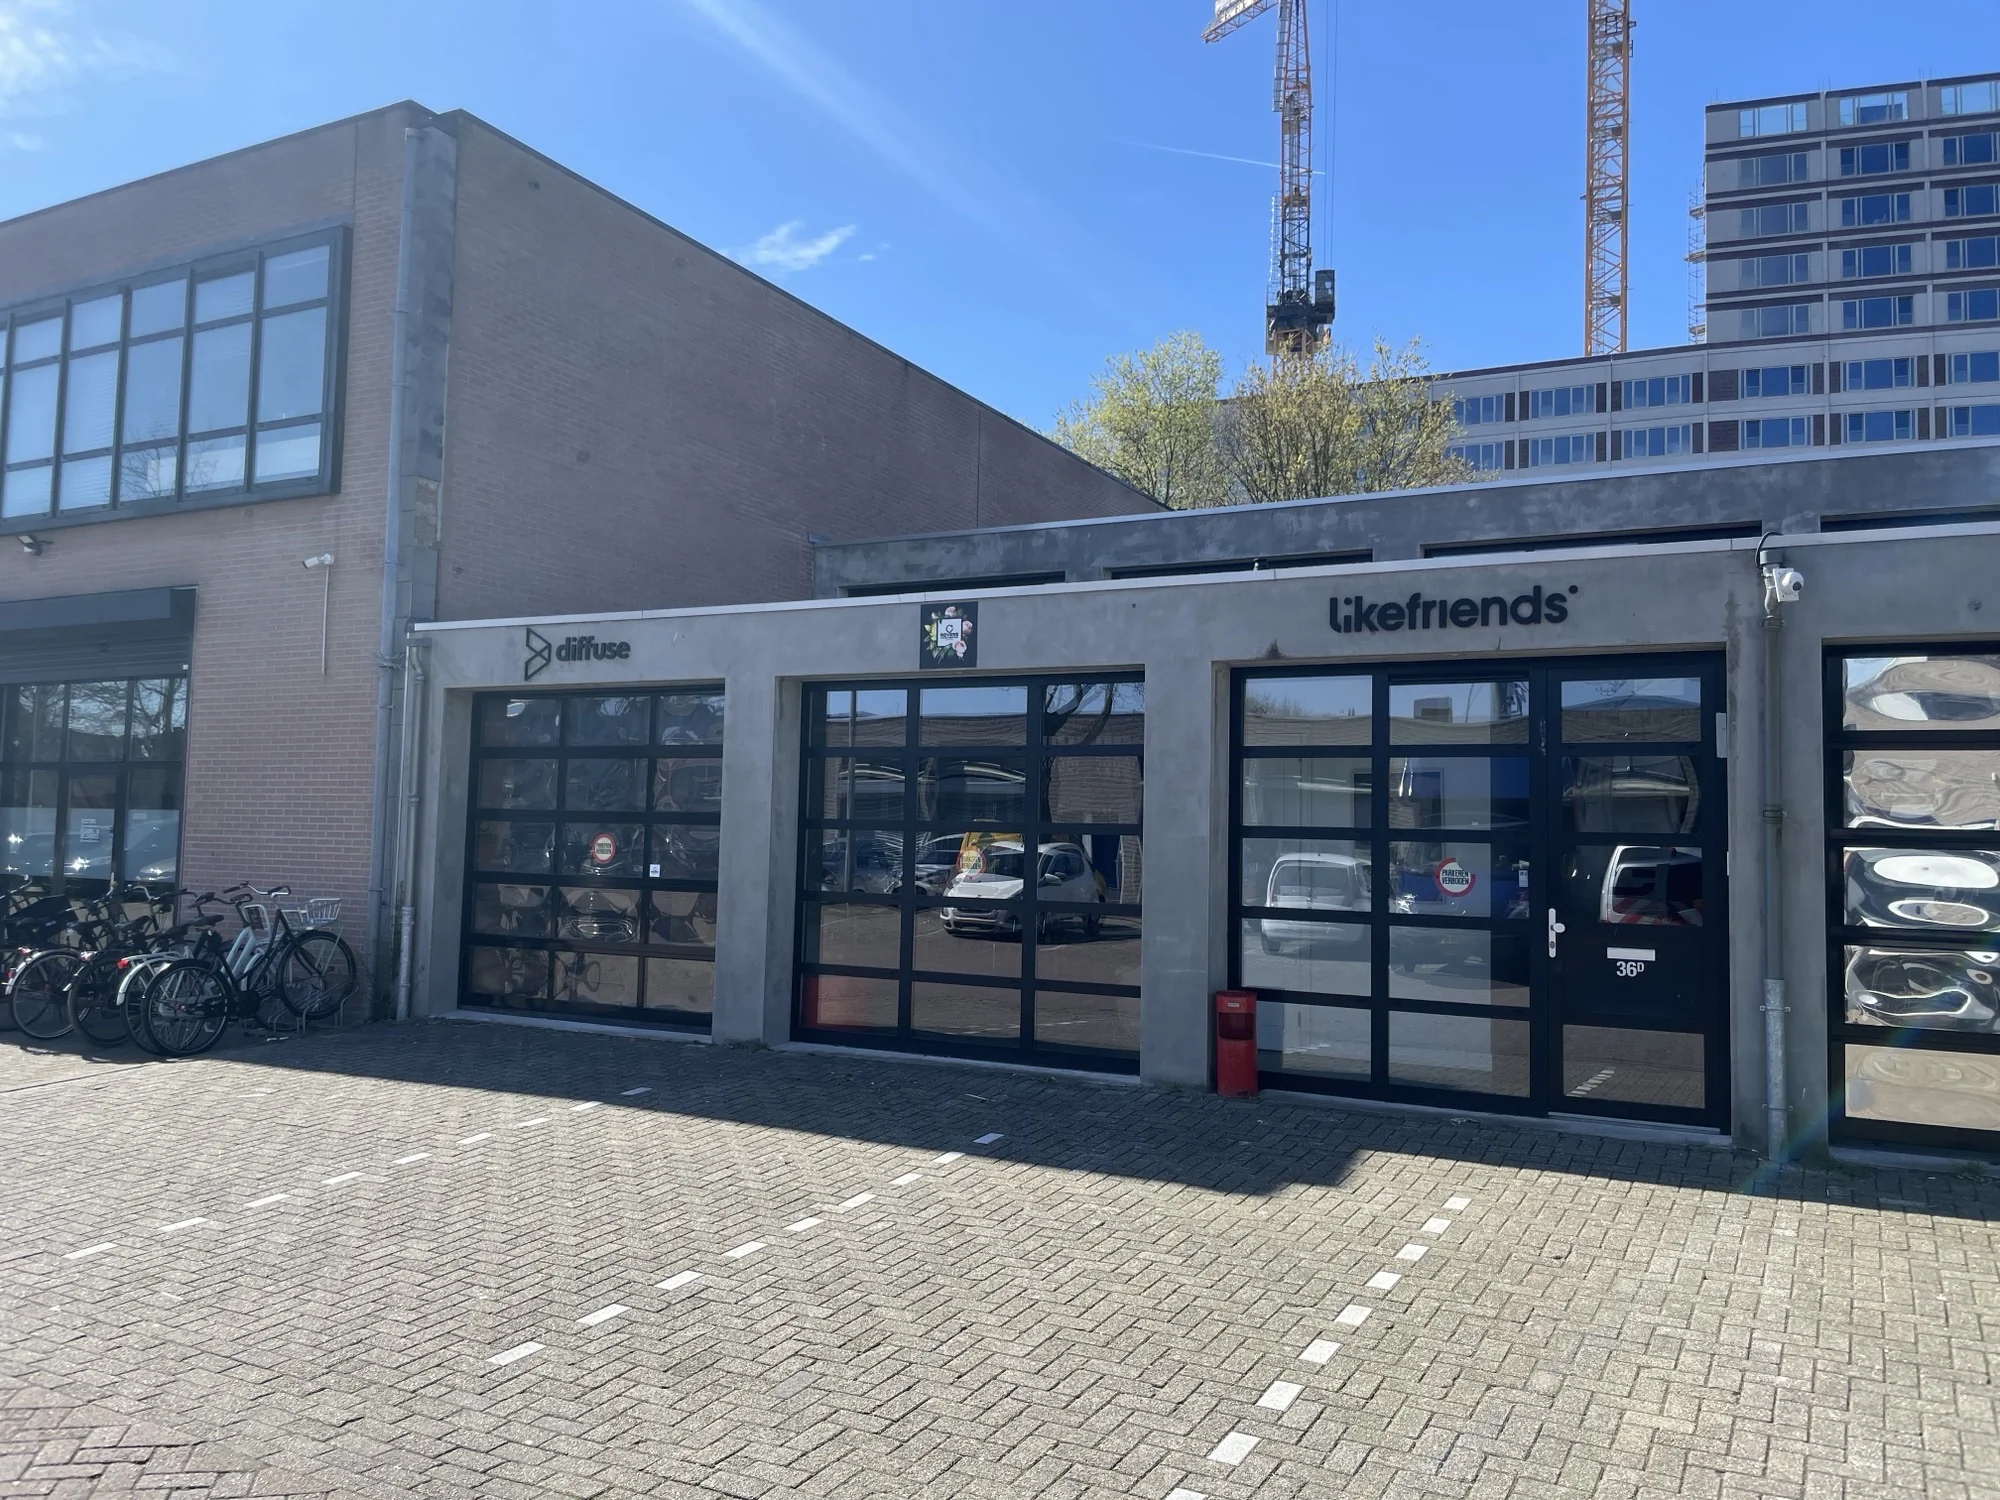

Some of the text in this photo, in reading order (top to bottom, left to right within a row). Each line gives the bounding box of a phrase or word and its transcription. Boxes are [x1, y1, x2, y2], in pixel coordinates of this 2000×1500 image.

[1329, 585, 1569, 633] likefriends
[555, 635, 631, 662] diffuse
[1442, 869, 1469, 877] PARKEREN
[1442, 877, 1469, 885] VERBODEN
[1616, 961, 1645, 977] 36D
